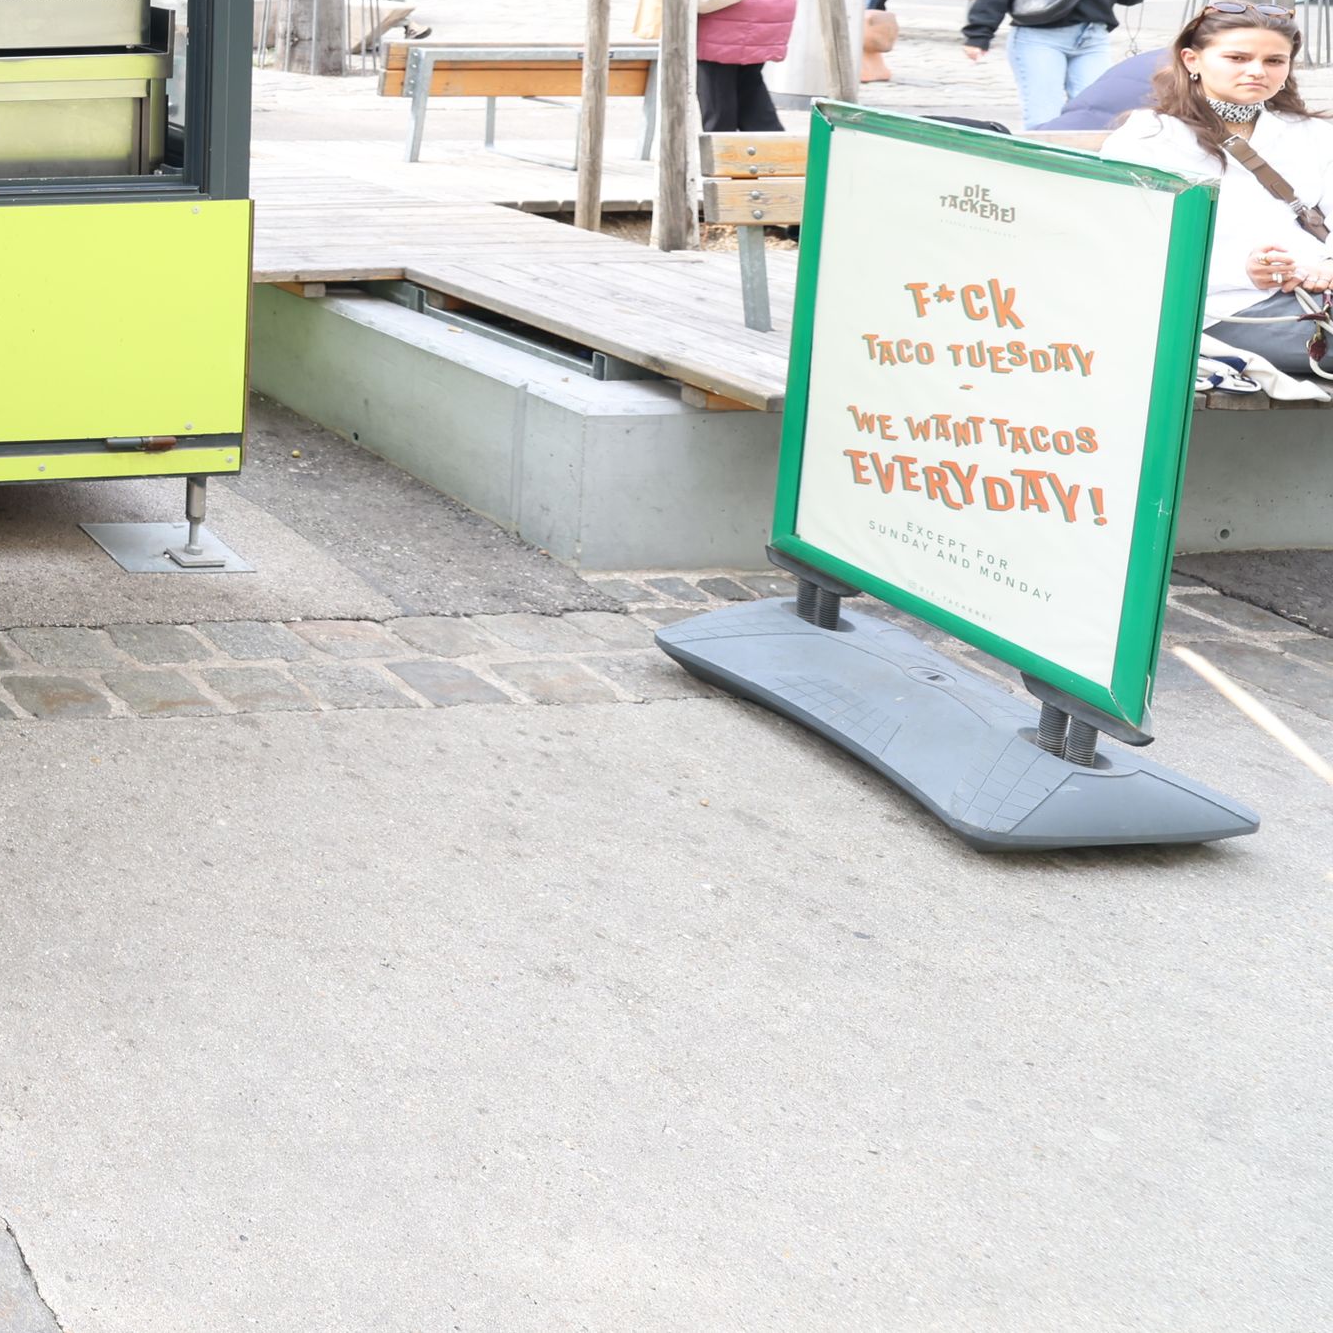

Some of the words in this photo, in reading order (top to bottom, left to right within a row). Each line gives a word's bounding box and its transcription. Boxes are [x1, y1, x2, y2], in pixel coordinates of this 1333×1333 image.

[940, 194, 1016, 223] TACKEREI
[964, 184, 992, 202] DIE
[862, 334, 935, 366] TACO
[947, 339, 1095, 377] TUESDAY
[846, 405, 899, 441] WE
[904, 414, 985, 447] WANT
[989, 418, 1099, 455] TACOS
[843, 449, 1108, 526] EVERYDAY!
[869, 520, 929, 552] SUNDAY
[937, 549, 971, 569] AND
[980, 566, 1053, 603] MONDAY
[906, 521, 968, 553] EXCEPT
[977, 549, 1009, 570] FOR
